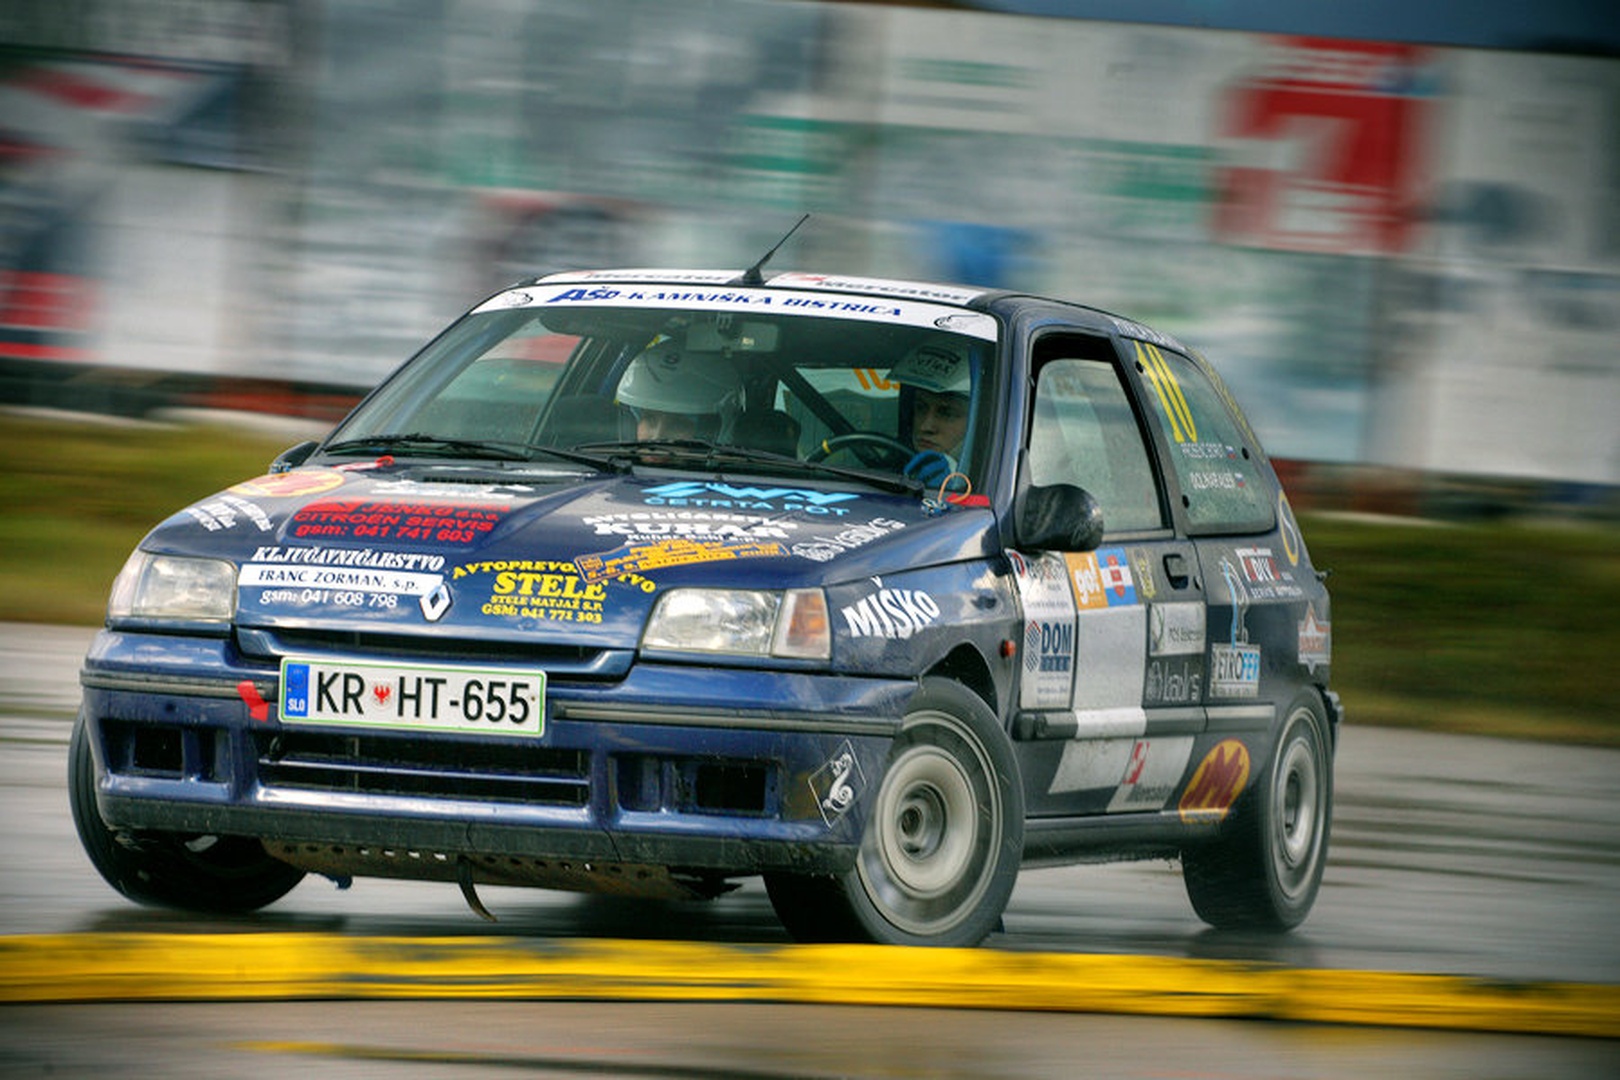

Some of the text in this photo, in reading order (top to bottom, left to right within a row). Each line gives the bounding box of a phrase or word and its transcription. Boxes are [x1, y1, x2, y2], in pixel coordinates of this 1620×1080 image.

[1133, 340, 1198, 443] 10
[784, 502, 851, 517] POT
[295, 524, 475, 543] gsm: 041 741 603
[405, 515, 495, 533] SERVIS
[594, 520, 790, 539] KUHAR
[251, 545, 445, 572] KLJUČAVNIČARSTVO
[259, 569, 309, 584] FRANC
[392, 579, 421, 592] s.p.
[259, 588, 399, 609] gsm: 041 608 798
[491, 594, 528, 605] STELE
[841, 575, 941, 640] MIŠKO
[481, 603, 517, 617] GSM:
[521, 606, 546, 620] 041
[576, 611, 603, 625] 303
[1041, 621, 1073, 654] DOM
[316, 671, 531, 725] KR HT-655
